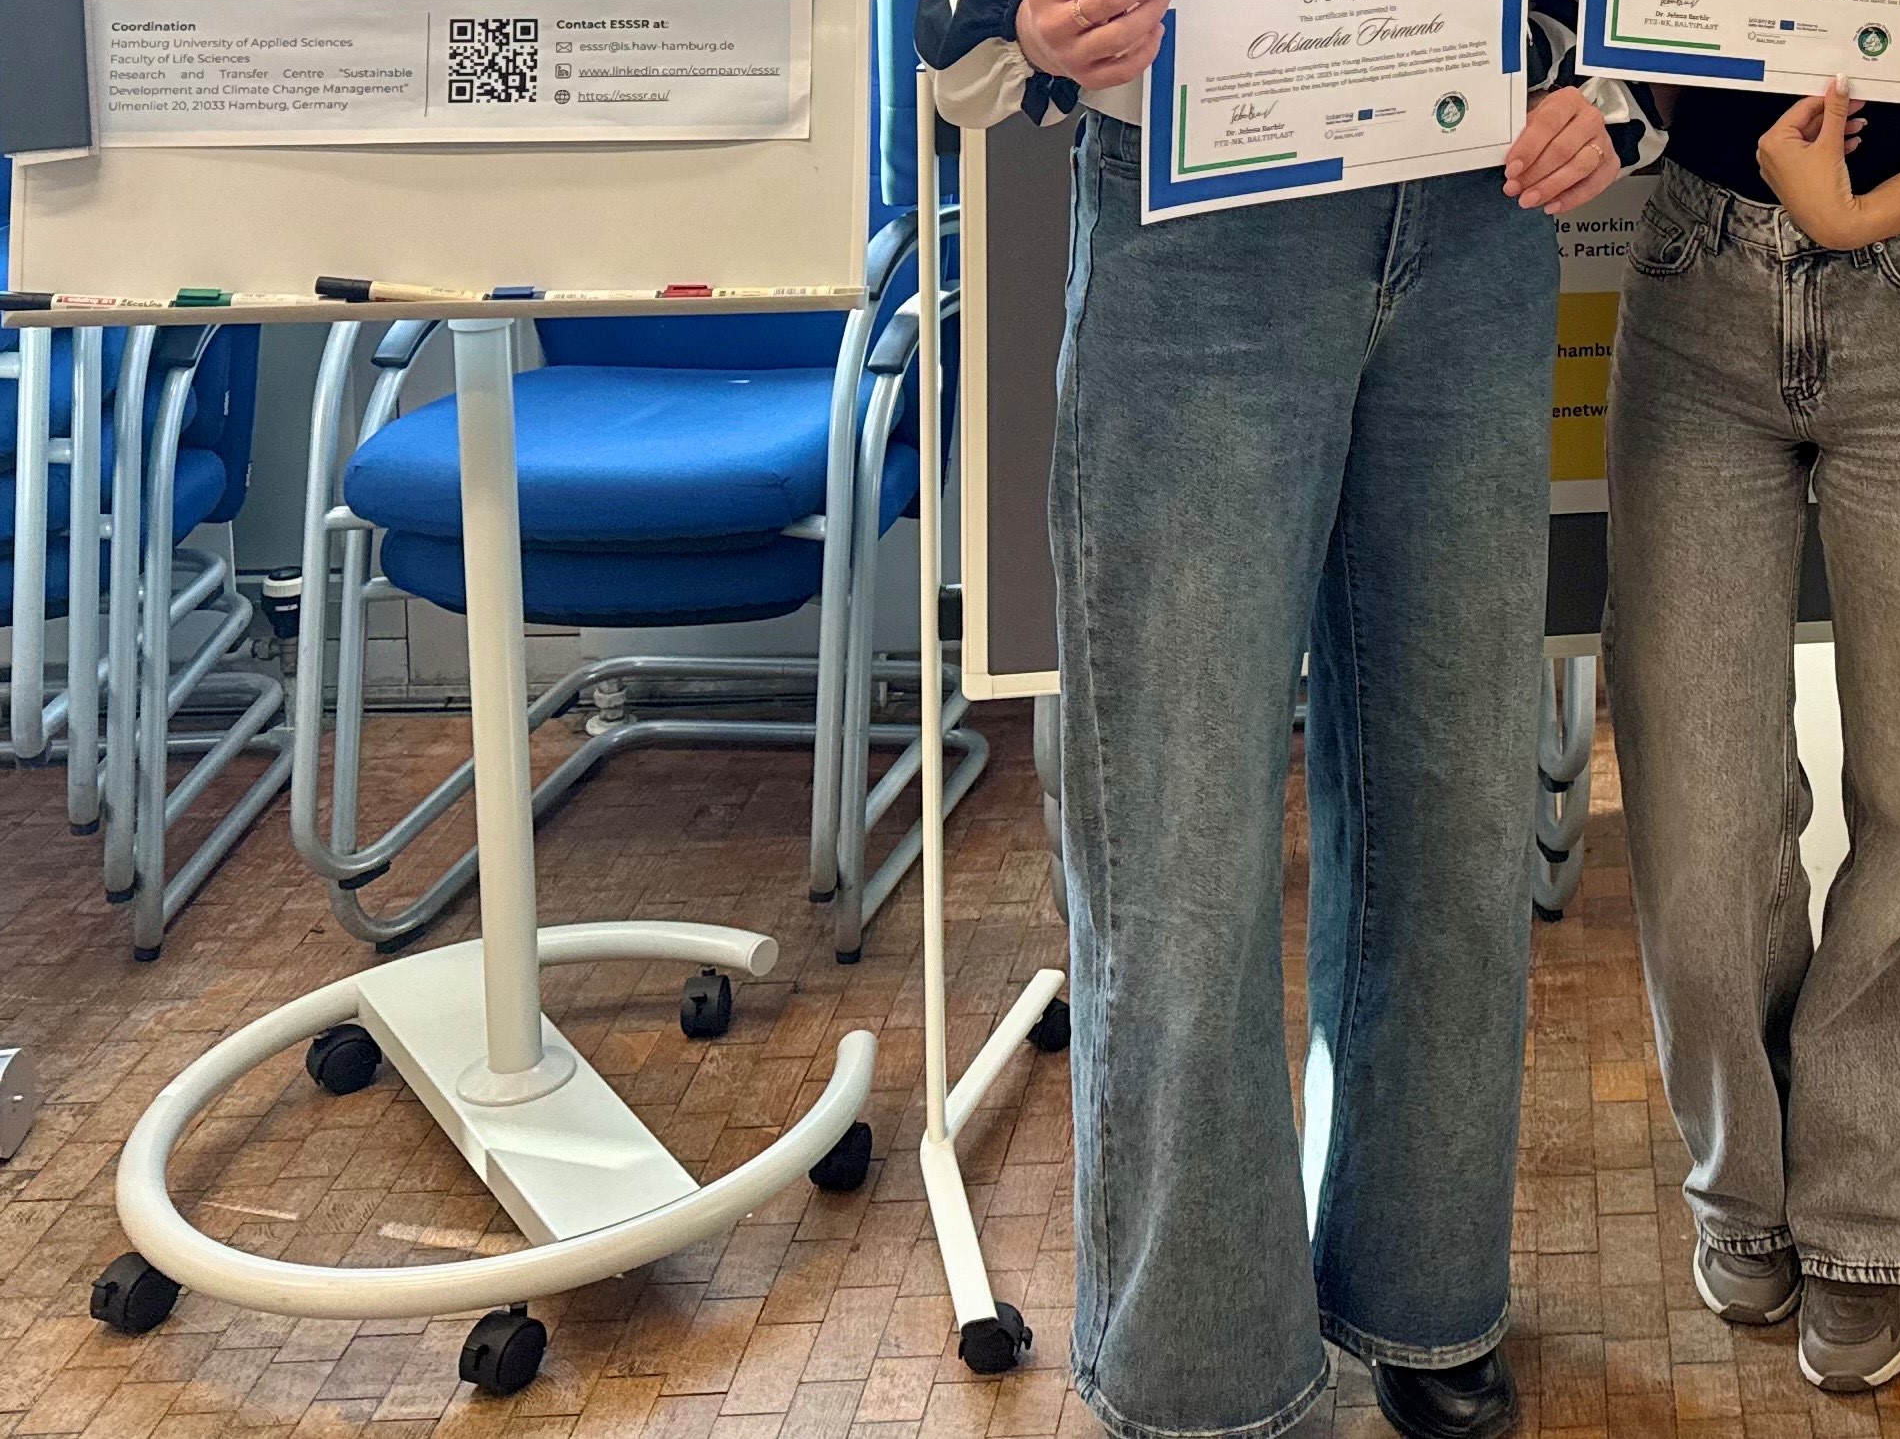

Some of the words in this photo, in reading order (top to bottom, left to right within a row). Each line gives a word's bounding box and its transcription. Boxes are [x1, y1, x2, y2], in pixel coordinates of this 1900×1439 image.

[111, 21, 197, 33] Coordination
[556, 19, 607, 31] Contact
[610, 19, 650, 31] ESSSR
[1247, 26, 1352, 60] Oleksandra
[577, 88, 671, 103] https://esssr.eu/
[1576, 217, 1640, 233] workin
